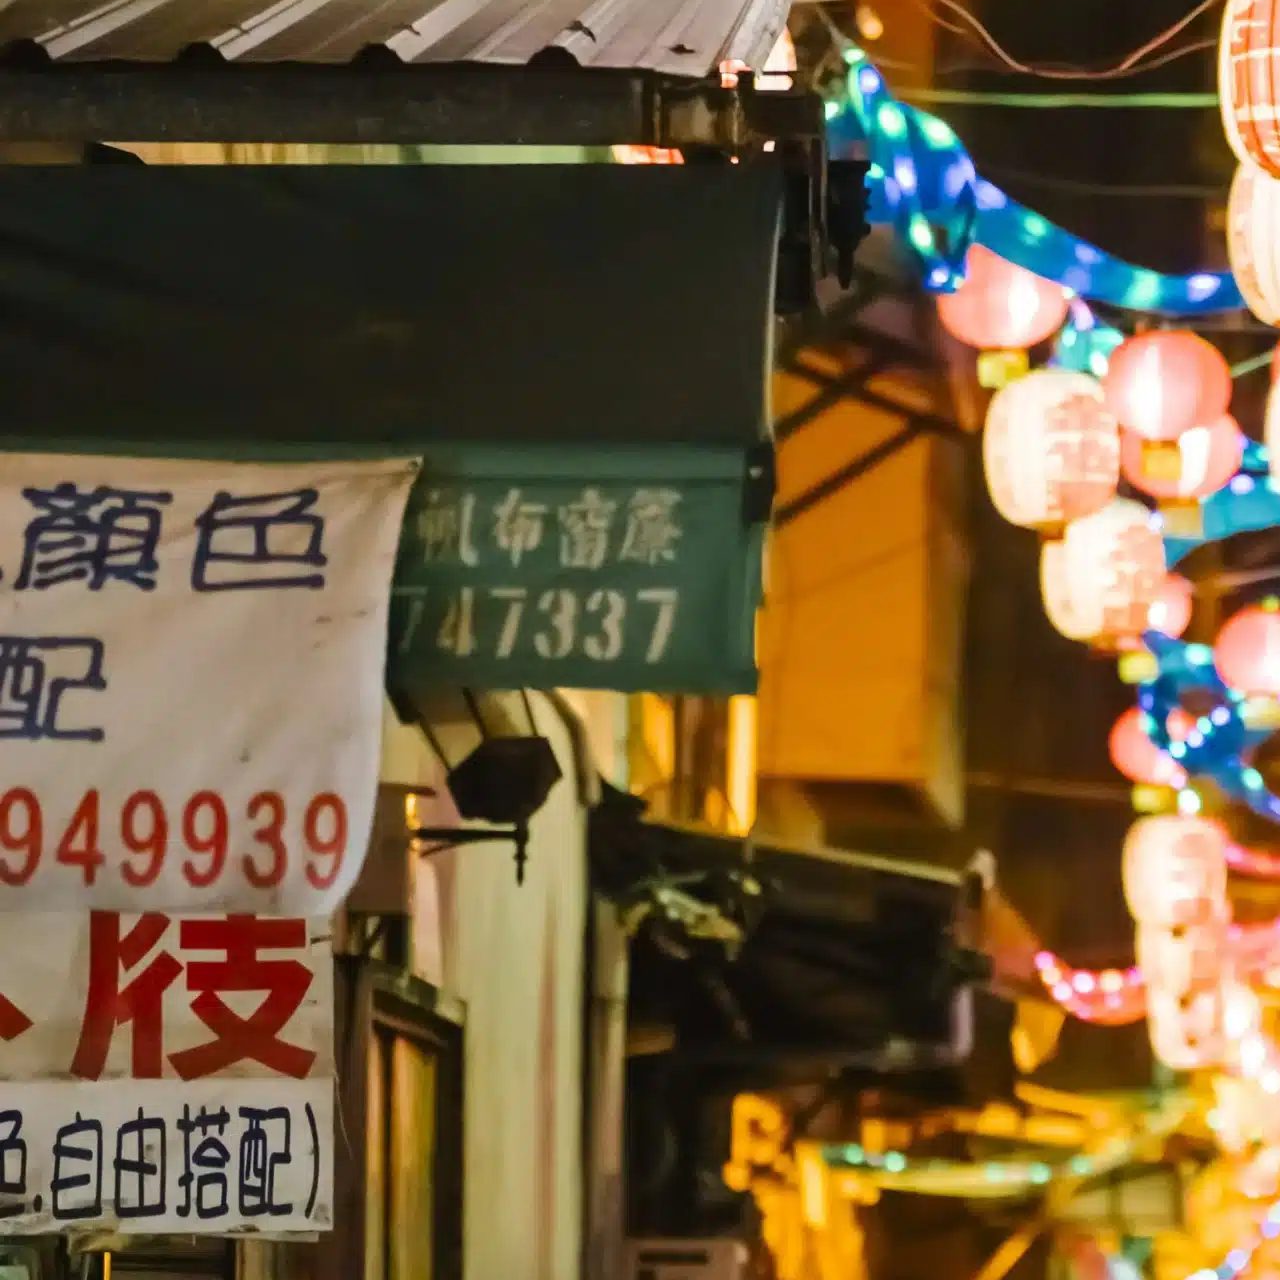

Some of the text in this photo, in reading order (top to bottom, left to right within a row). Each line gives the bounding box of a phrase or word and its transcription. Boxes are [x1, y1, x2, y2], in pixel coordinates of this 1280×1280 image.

[13, 482, 327, 591] 顏色
[0, 637, 107, 741] 配
[0, 786, 349, 890] 949939
